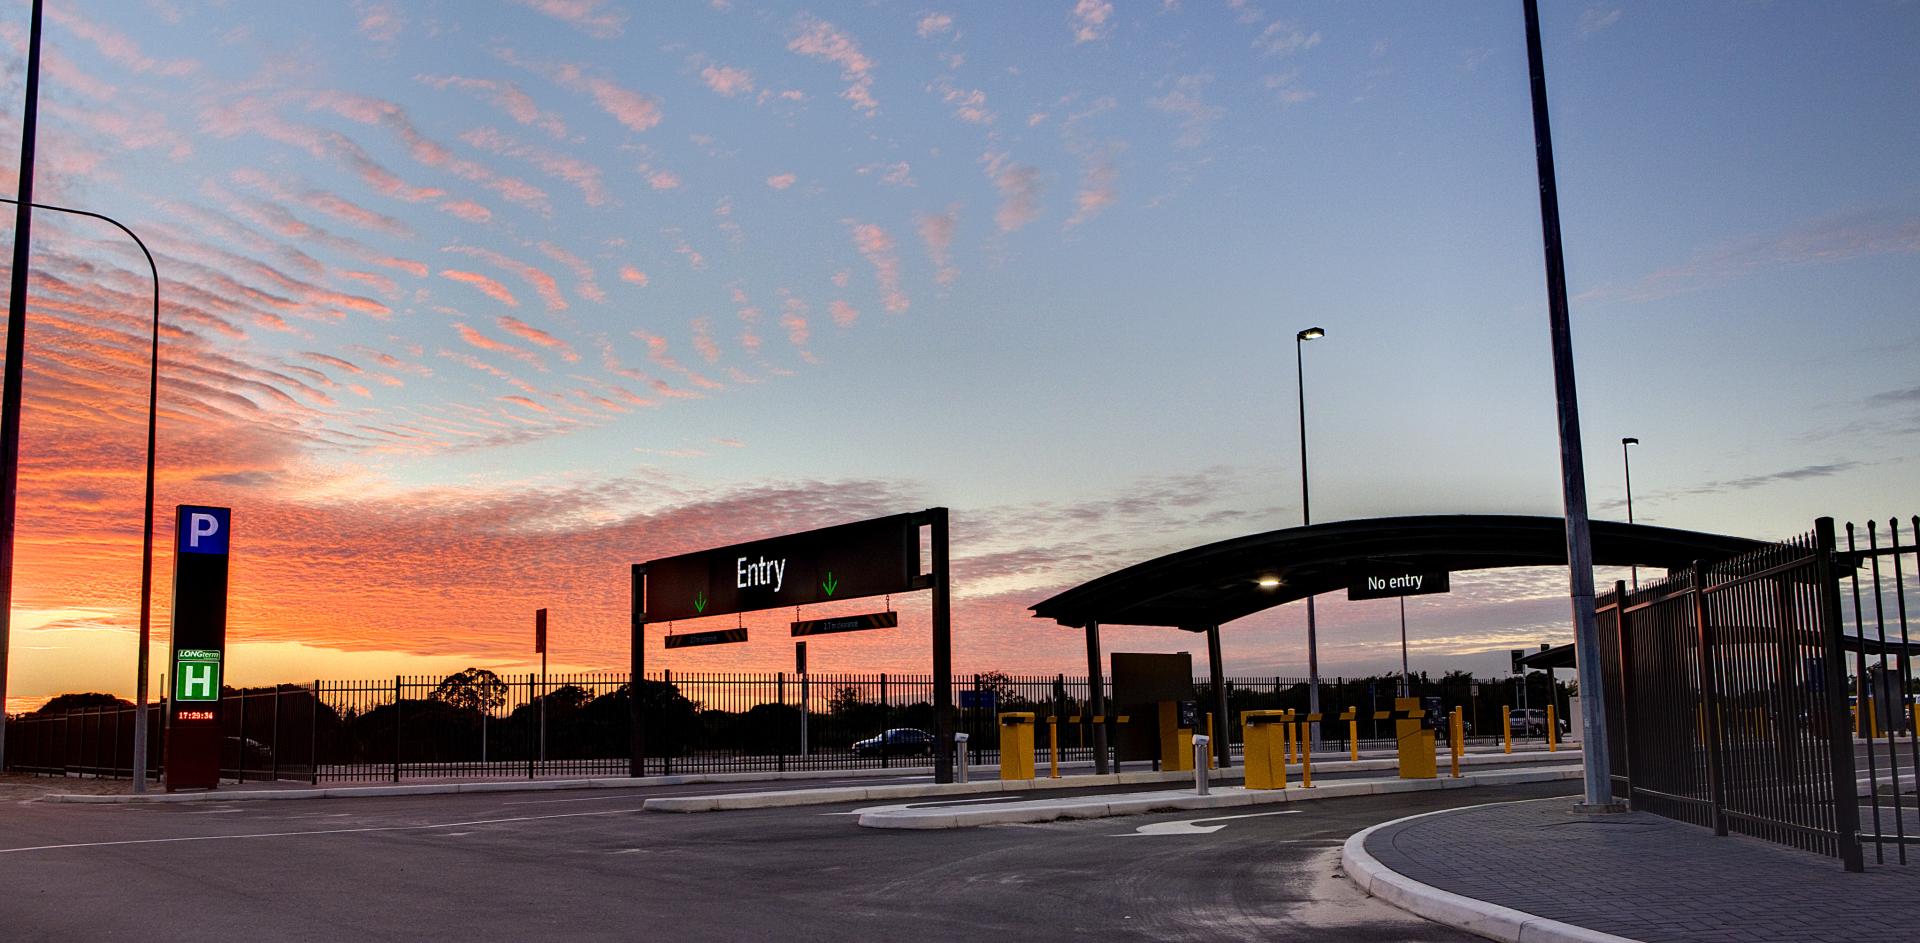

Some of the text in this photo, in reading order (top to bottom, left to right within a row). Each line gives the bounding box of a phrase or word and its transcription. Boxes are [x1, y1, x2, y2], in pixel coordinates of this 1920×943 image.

[190, 513, 219, 547] P
[737, 556, 786, 593] Entry
[1368, 573, 1423, 590] No entry
[185, 666, 211, 697] H
